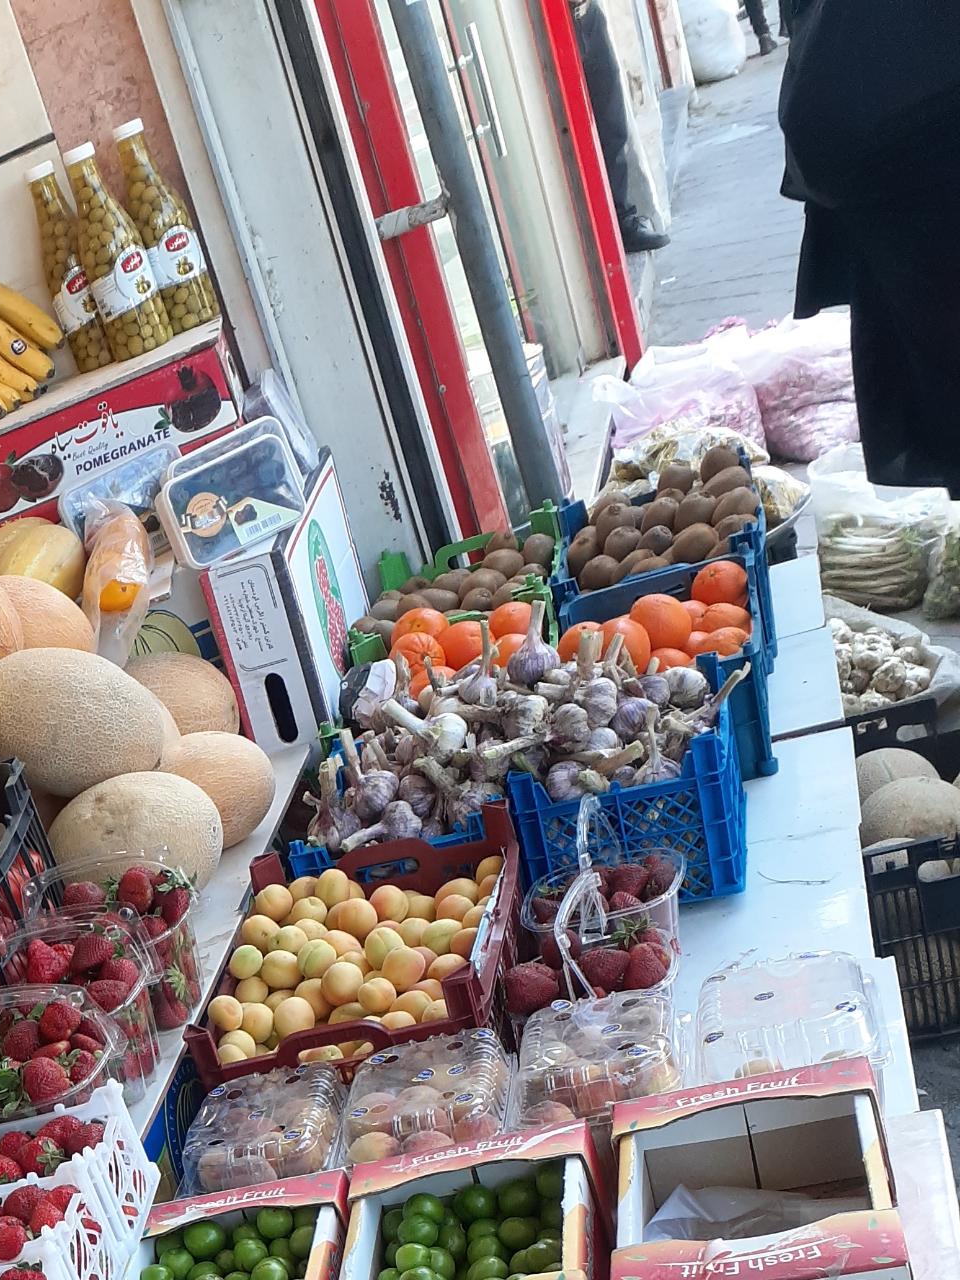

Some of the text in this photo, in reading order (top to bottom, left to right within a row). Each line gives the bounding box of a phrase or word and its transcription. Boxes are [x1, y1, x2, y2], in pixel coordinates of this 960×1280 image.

[50, 401, 124, 460] یاقوت سیاه
[75, 428, 171, 476] POMEGRANATE
[675, 1073, 802, 1107] Fresh Fruit
[412, 1135, 525, 1167] Fresh Fruit
[243, 1187, 286, 1200] Fruit
[749, 1245, 822, 1271] Fresh
